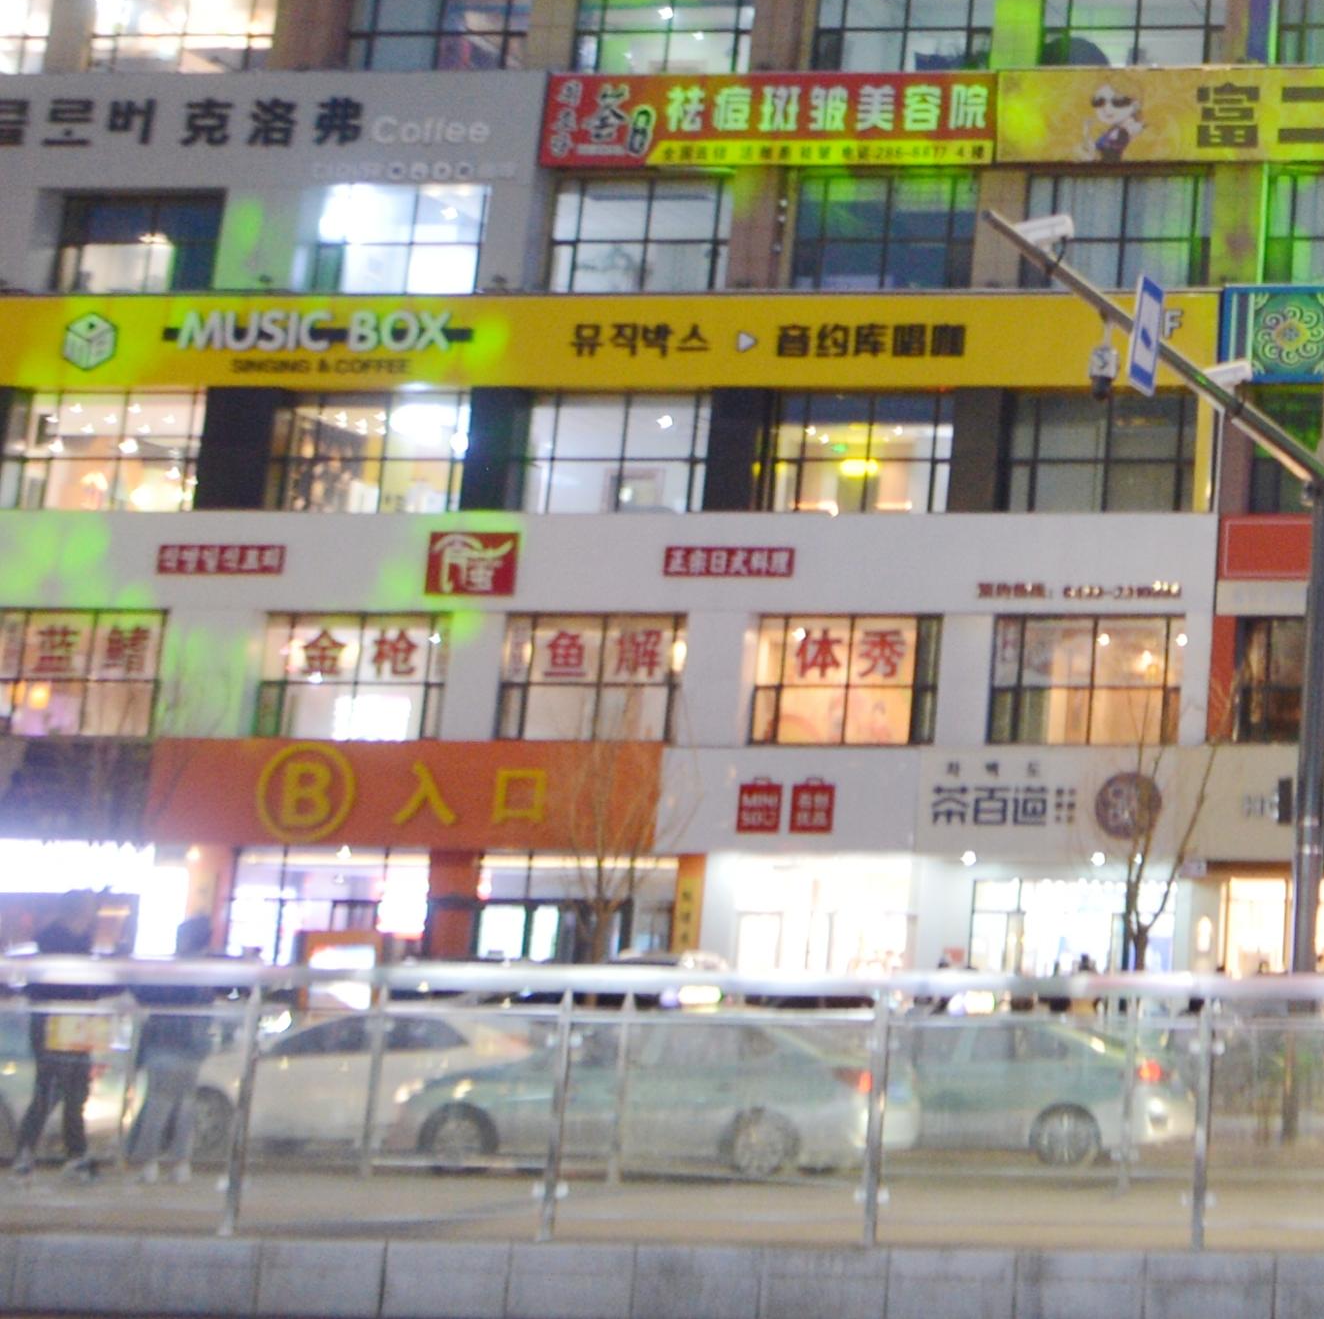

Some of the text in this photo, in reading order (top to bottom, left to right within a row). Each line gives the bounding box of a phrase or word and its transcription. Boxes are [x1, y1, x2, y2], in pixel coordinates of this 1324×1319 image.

[181, 97, 364, 147] 克洛弗
[371, 115, 491, 145] Coffee
[177, 309, 453, 353] MUSIC BOX
[570, 322, 710, 358] 뮤직박스
[334, 358, 412, 374] COFFEE
[395, 762, 550, 826] 入口
[931, 785, 1047, 826] 茶百道
